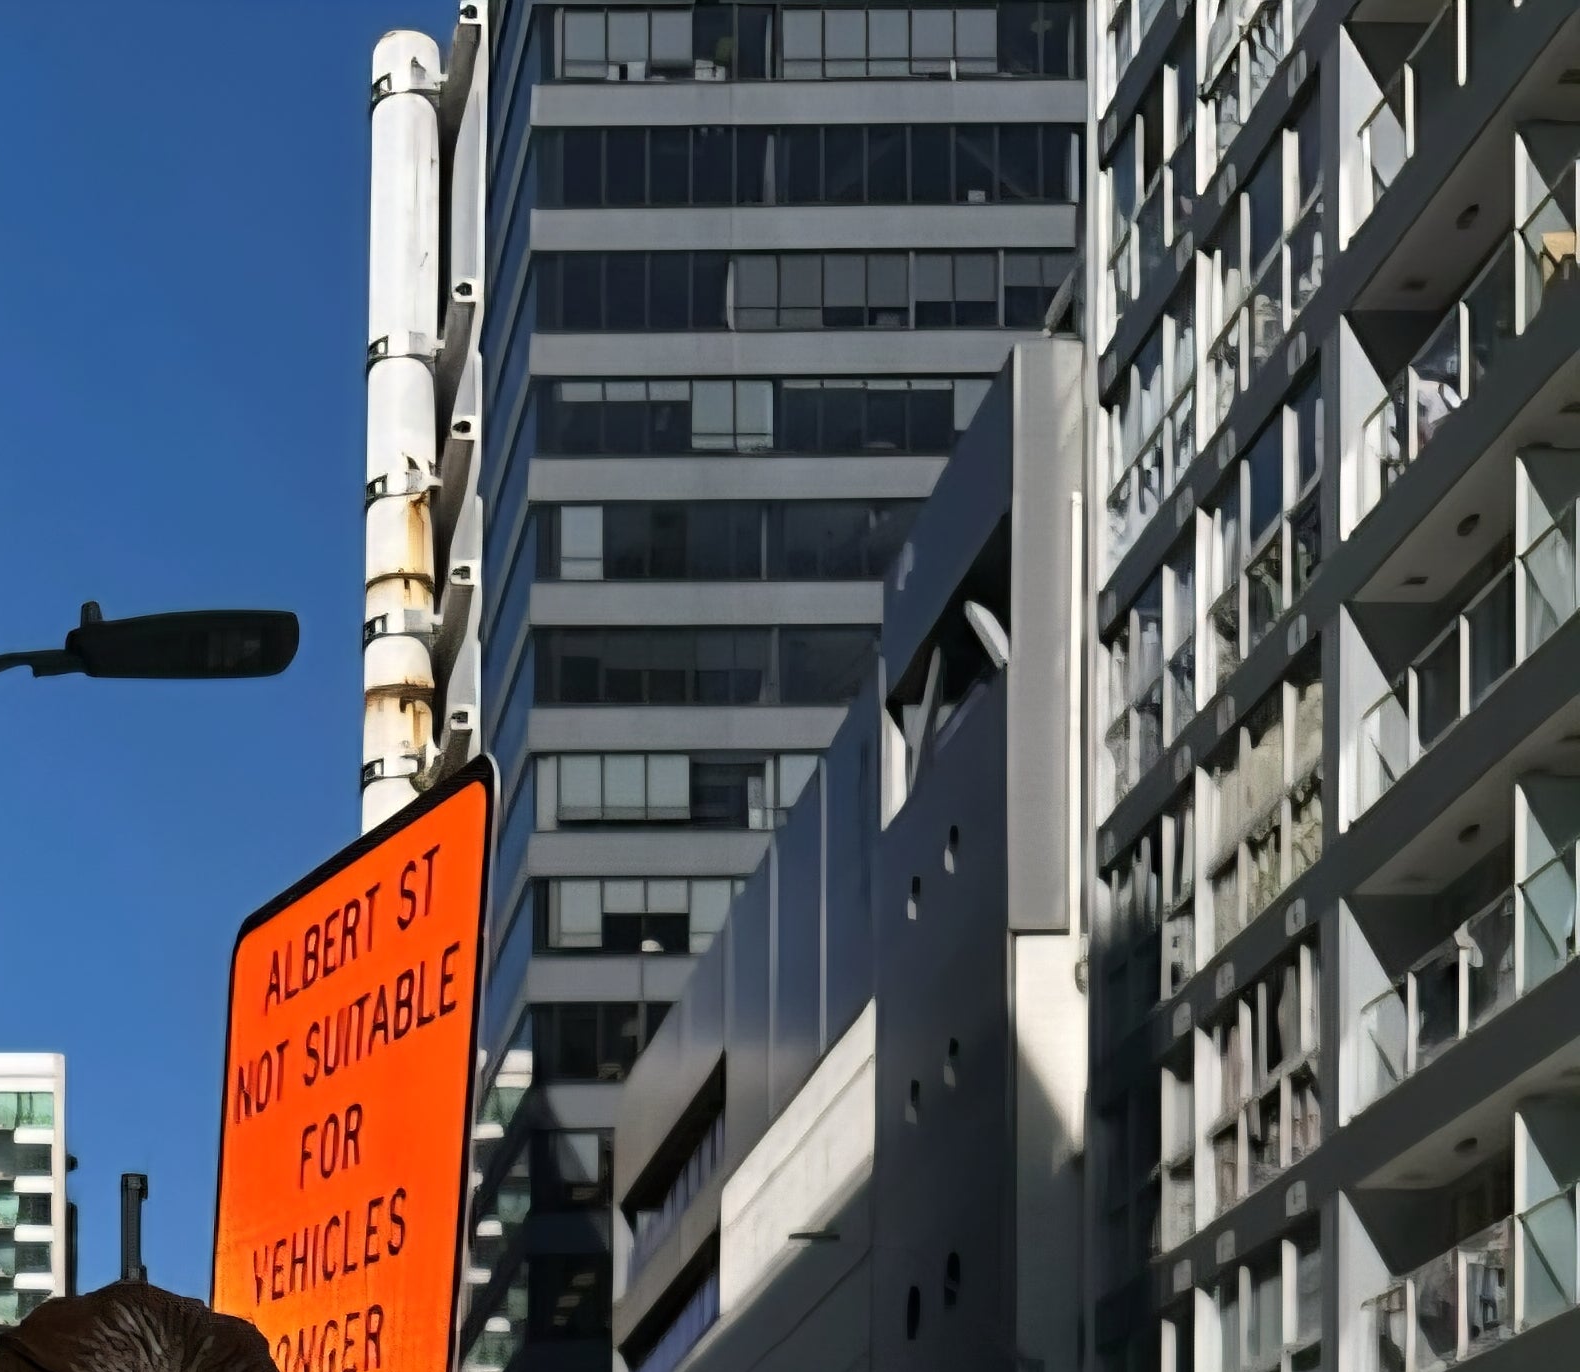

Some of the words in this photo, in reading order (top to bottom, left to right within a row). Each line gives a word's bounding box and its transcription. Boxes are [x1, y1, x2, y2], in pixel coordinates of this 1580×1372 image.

[265, 883, 380, 1015] ALBERT
[397, 844, 440, 931] ST
[233, 1040, 289, 1124] NOT
[303, 941, 460, 1086] SUITABLE
[300, 1103, 363, 1189] FOR
[253, 1187, 407, 1305] VEHICLES
